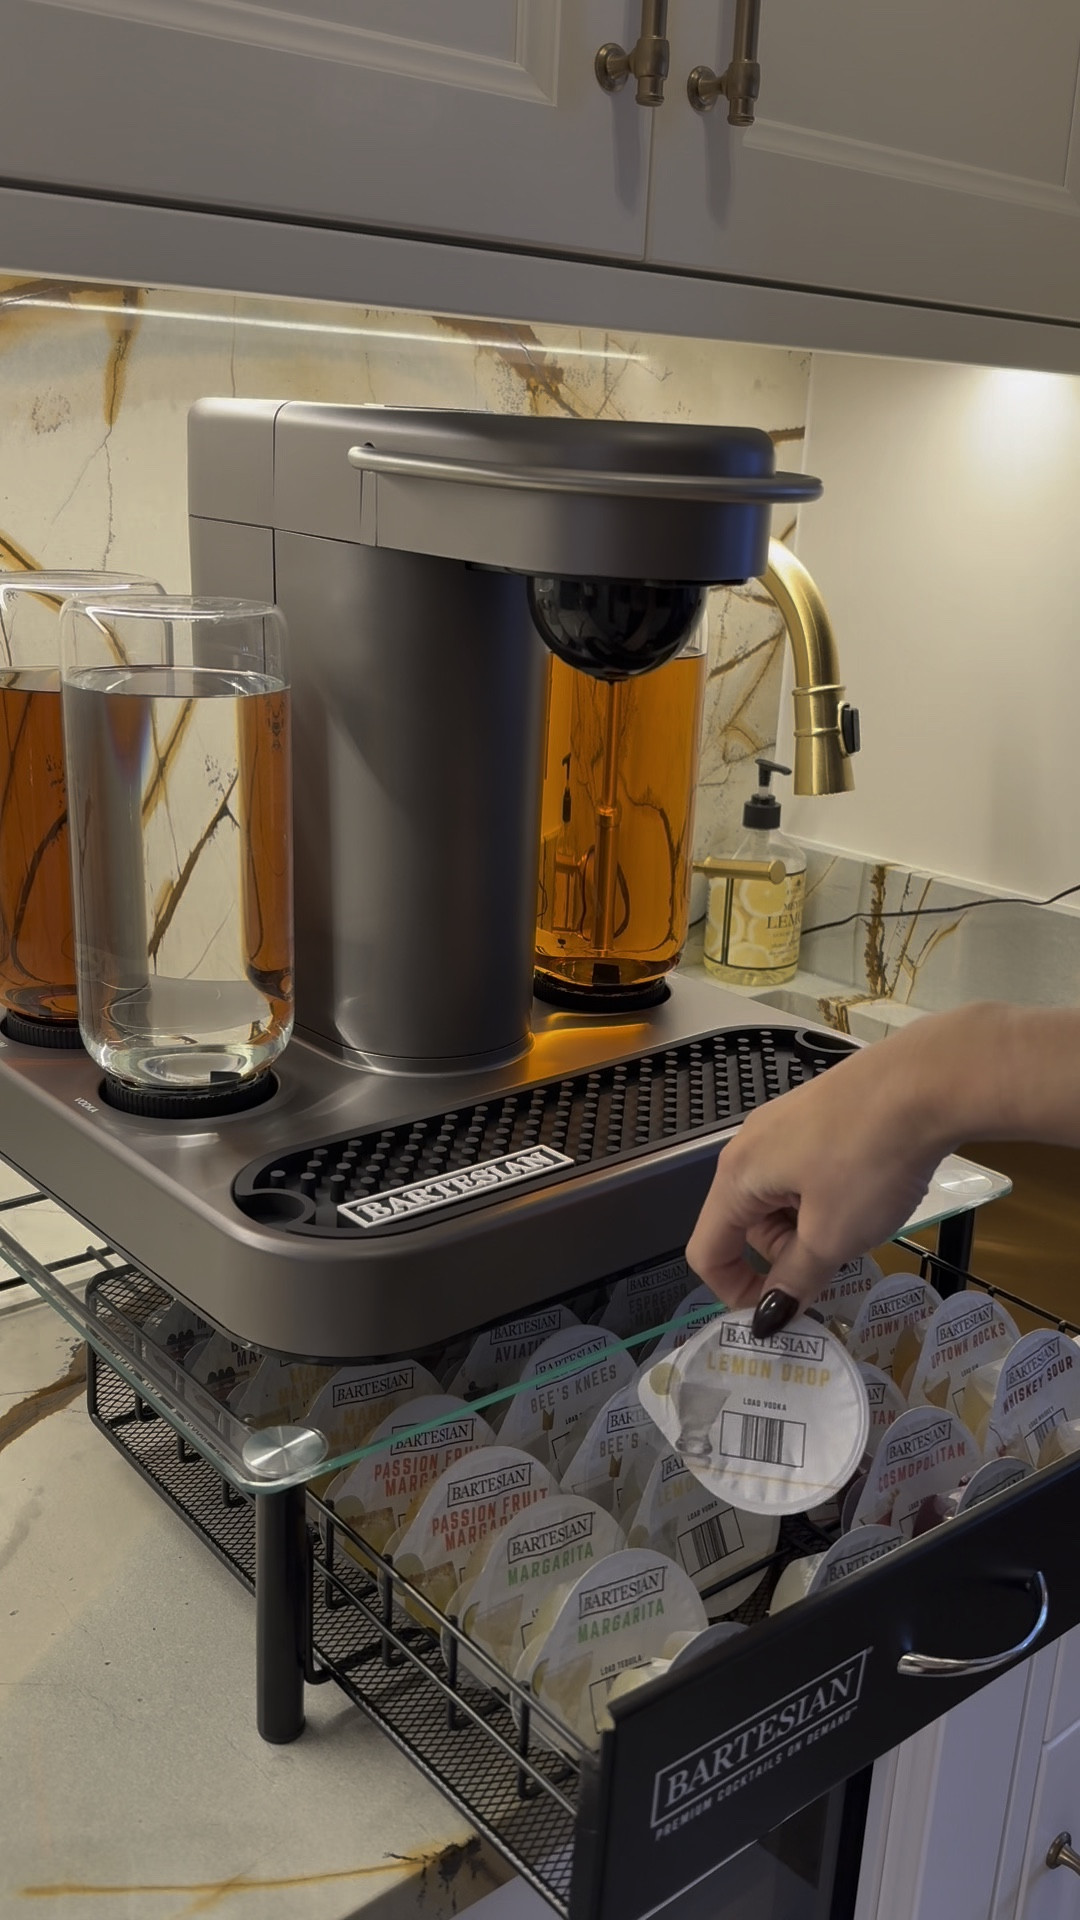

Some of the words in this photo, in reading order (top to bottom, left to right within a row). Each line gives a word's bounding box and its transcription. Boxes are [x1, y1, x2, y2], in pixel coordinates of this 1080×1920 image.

[356, 1151, 555, 1222] BARTESIAN
[630, 1264, 685, 1291] BARTESIAN
[840, 1278, 872, 1297] ROCKS
[629, 1283, 687, 1314] ESPRESSO
[871, 1290, 922, 1317] BARTESIAN
[493, 1315, 557, 1340] BARTESIAN
[860, 1320, 899, 1344] UPTOWN
[903, 1306, 935, 1329] ROCKS
[940, 1308, 990, 1341] BARTESIAN
[931, 1342, 969, 1369] UPTOWN
[973, 1322, 1006, 1348] ROCKS
[706, 1352, 772, 1379] LEMON
[781, 1365, 831, 1387] DROP
[1008, 1343, 1058, 1385] BARTESIAN
[337, 1373, 409, 1402] BARTESIAN
[531, 1385, 569, 1414] BEE'S
[575, 1364, 617, 1395] KNEES
[1003, 1374, 1044, 1415] WHISKEY
[1047, 1356, 1073, 1382] SOUR
[743, 1397, 761, 1408] LOAD
[764, 1400, 787, 1411] VODKA
[395, 1424, 469, 1450] BARTESIAN
[600, 1432, 639, 1458] BEE'S
[889, 1425, 947, 1459] BARTESIAN
[374, 1453, 438, 1482] PASSION
[452, 1469, 526, 1501] BARTESIAN
[878, 1442, 966, 1493] COSMOPOLITAN
[432, 1501, 497, 1536] PASSION
[503, 1488, 548, 1514] FRUIT
[511, 1519, 590, 1556] BARTESIAN
[508, 1541, 595, 1587] MARGARITA
[582, 1574, 661, 1611] BARTESIAN
[578, 1598, 665, 1644] MARGARITA
[600, 1663, 616, 1676] LOAD
[665, 1667, 855, 1808] BARTESIAN
[655, 1797, 712, 1841] PREMIUM
[717, 1752, 783, 1802] COCKTAILS
[787, 1742, 803, 1757] ON
[806, 1711, 852, 1746] DEMAND
